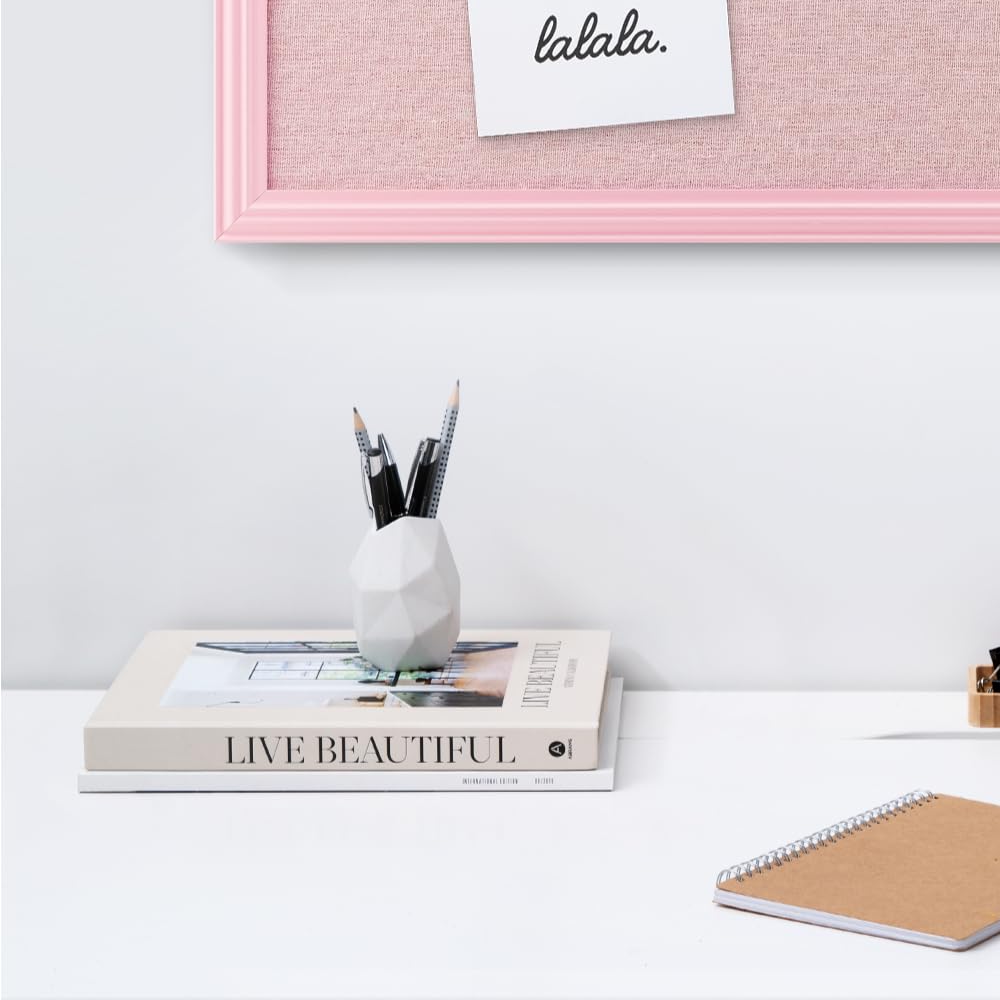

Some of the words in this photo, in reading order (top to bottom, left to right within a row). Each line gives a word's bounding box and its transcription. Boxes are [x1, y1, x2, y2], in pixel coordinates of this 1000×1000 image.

[534, 8, 667, 63] lalala.
[521, 687, 552, 708] LIVE
[225, 736, 304, 764] LIVE
[316, 736, 516, 764] BEAUTIFUL
